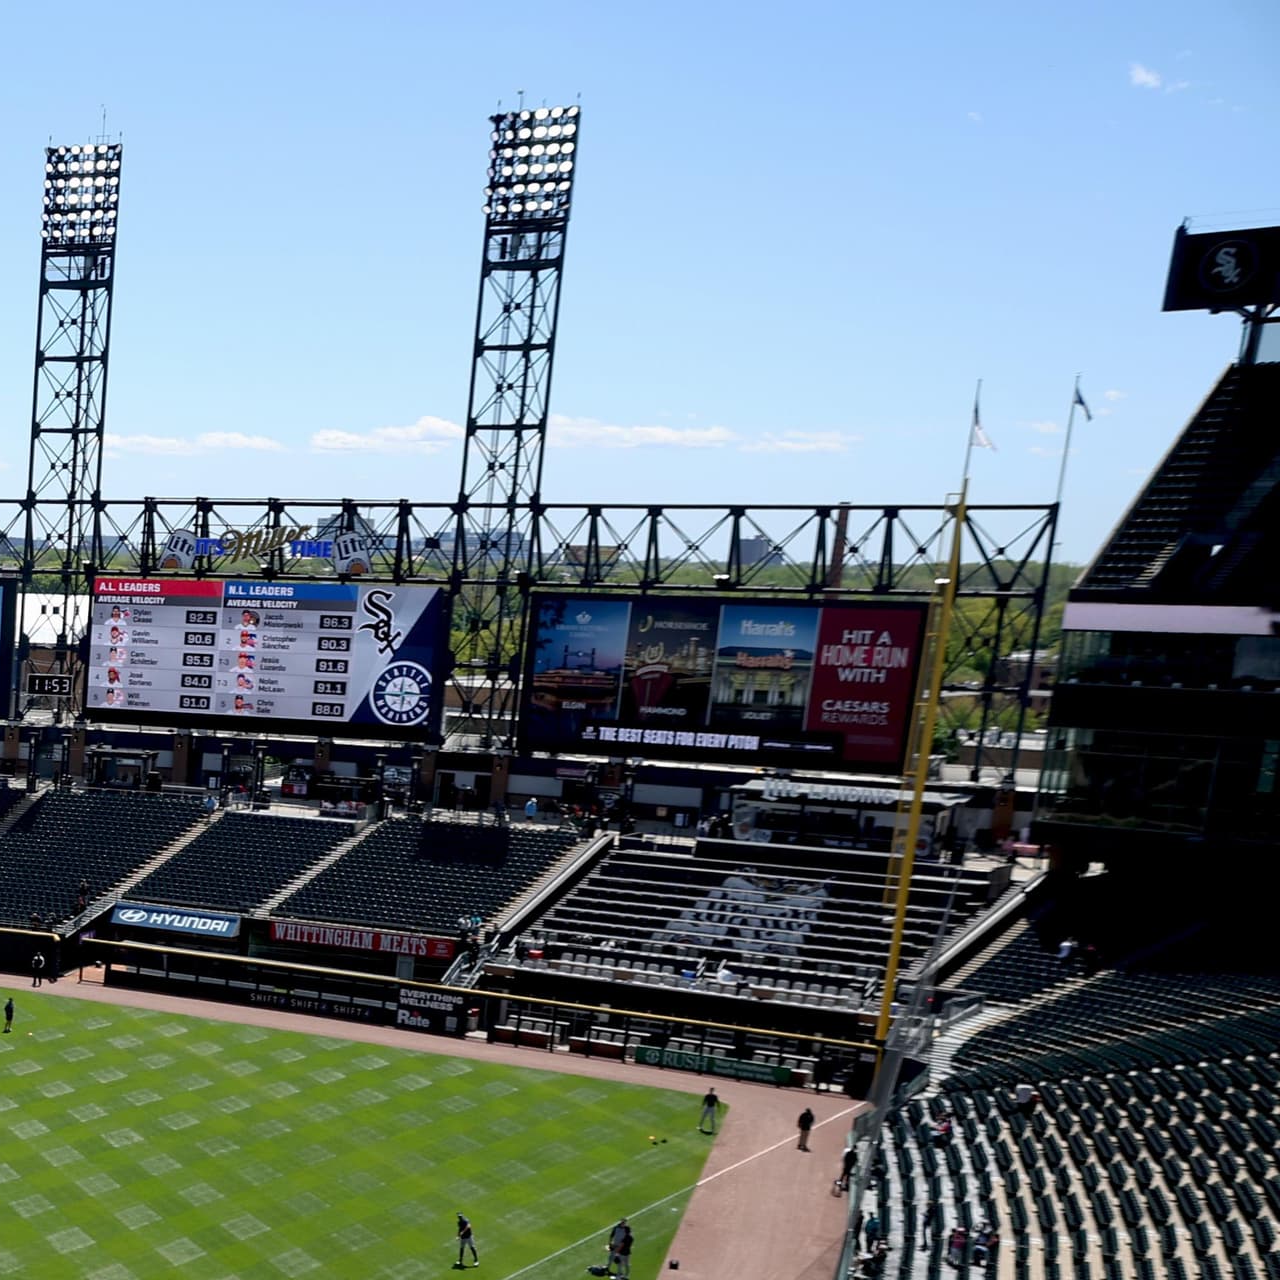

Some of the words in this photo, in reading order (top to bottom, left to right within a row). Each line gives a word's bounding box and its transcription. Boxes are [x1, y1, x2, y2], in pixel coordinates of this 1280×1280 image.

[219, 525, 313, 564] Miller
[290, 539, 334, 558] TIME
[119, 582, 161, 592] LEADERS
[249, 586, 294, 597] LEADERS
[98, 595, 131, 603] AVERAGE
[132, 596, 166, 605] VELOCITY
[226, 599, 261, 608] AVERAGE
[262, 601, 298, 609] VELOCITY
[189, 612, 214, 623] 92.5
[322, 617, 349, 628] 96.3
[187, 634, 212, 645] 90.6
[842, 630, 872, 645] HIT
[875, 630, 892, 646] A
[321, 639, 347, 650] 90.3
[185, 655, 210, 666] 95.5
[821, 645, 871, 667] HOME
[874, 647, 909, 669] RUN
[319, 661, 345, 672] 91.6
[184, 676, 209, 687] 94.0
[838, 668, 886, 684] WITH
[35, 678, 70, 692] 11:53
[317, 683, 343, 694] 91.1
[182, 697, 207, 708] 91.0
[821, 699, 890, 714] CAESARS
[315, 705, 341, 715] 88.0
[599, 727, 617, 741] THE
[618, 728, 642, 743] BEST
[149, 911, 231, 934] HYUNDAI
[274, 922, 373, 950] WHITTINGHAM
[380, 933, 427, 956] MEATS
[398, 988, 464, 1005] EVERYTHING
[250, 993, 277, 1003] SHIFT
[290, 999, 319, 1010] SHIFT
[333, 1005, 361, 1016] SHIFT
[398, 996, 454, 1011] WELLNESS
[397, 1008, 430, 1028] Rate
[662, 1047, 708, 1072] RUSH
